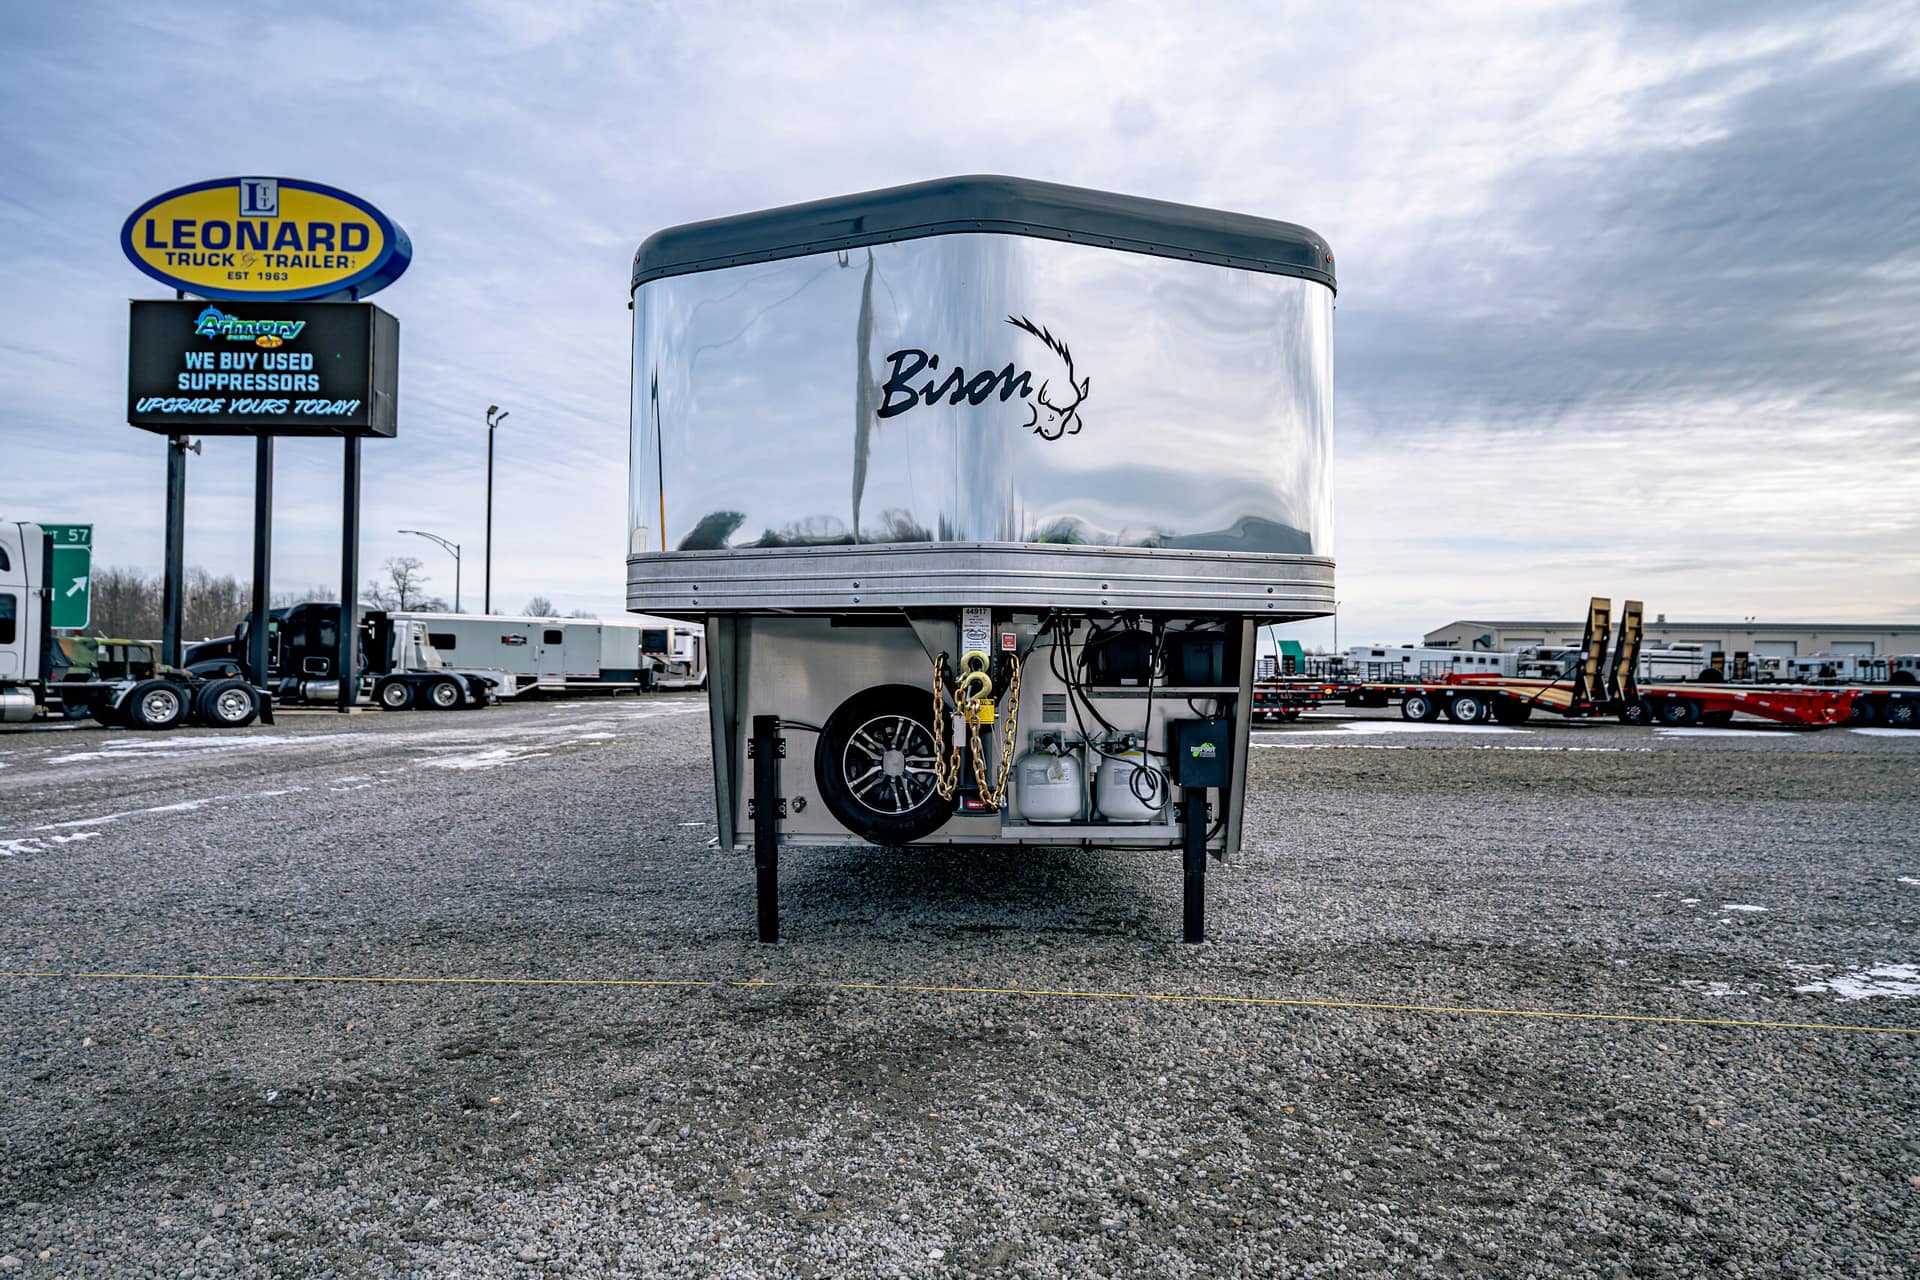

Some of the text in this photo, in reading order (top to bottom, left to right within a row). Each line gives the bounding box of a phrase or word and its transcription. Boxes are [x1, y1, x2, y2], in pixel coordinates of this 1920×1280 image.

[144, 219, 370, 253] LEONARD
[165, 252, 235, 268] TRUCK
[264, 254, 349, 269] TRAILER
[227, 271, 289, 281] EST 1963
[195, 316, 306, 339] Armory
[185, 352, 314, 371] WE BUY USED
[178, 373, 320, 392] SUPPRESSORS
[877, 348, 1034, 419] Bison
[136, 397, 360, 416] UPGRADE YOURS TODAY!
[68, 528, 89, 542] 57
